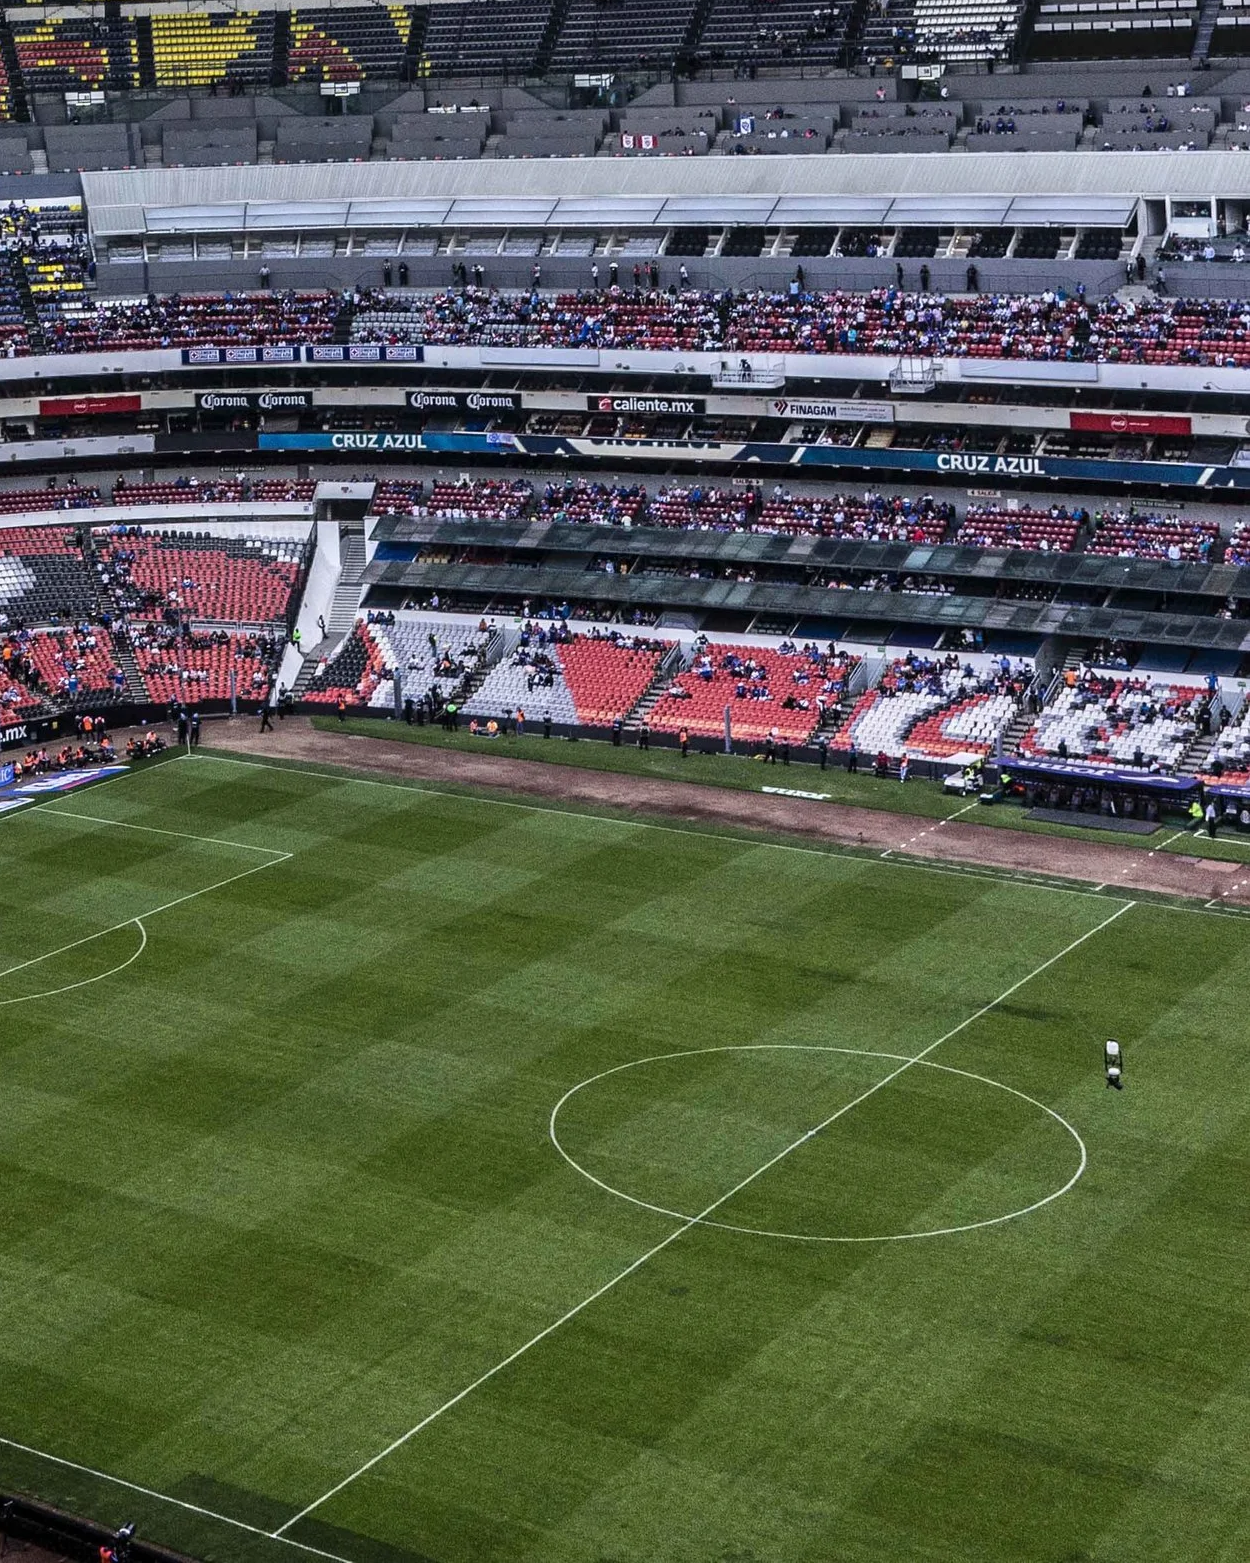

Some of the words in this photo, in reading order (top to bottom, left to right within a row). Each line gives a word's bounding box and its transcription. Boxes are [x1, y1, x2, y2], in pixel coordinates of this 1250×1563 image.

[200, 394, 248, 410] Corona
[258, 393, 306, 410] Corona
[410, 393, 457, 409] Corona
[466, 393, 513, 411] Corona
[613, 397, 694, 413] caliente.mx
[790, 404, 837, 417] FINAGAM
[332, 434, 378, 448] CRUZ
[382, 434, 427, 449] AZUL
[937, 454, 990, 471] CRUZ
[994, 457, 1045, 474] AZUL
